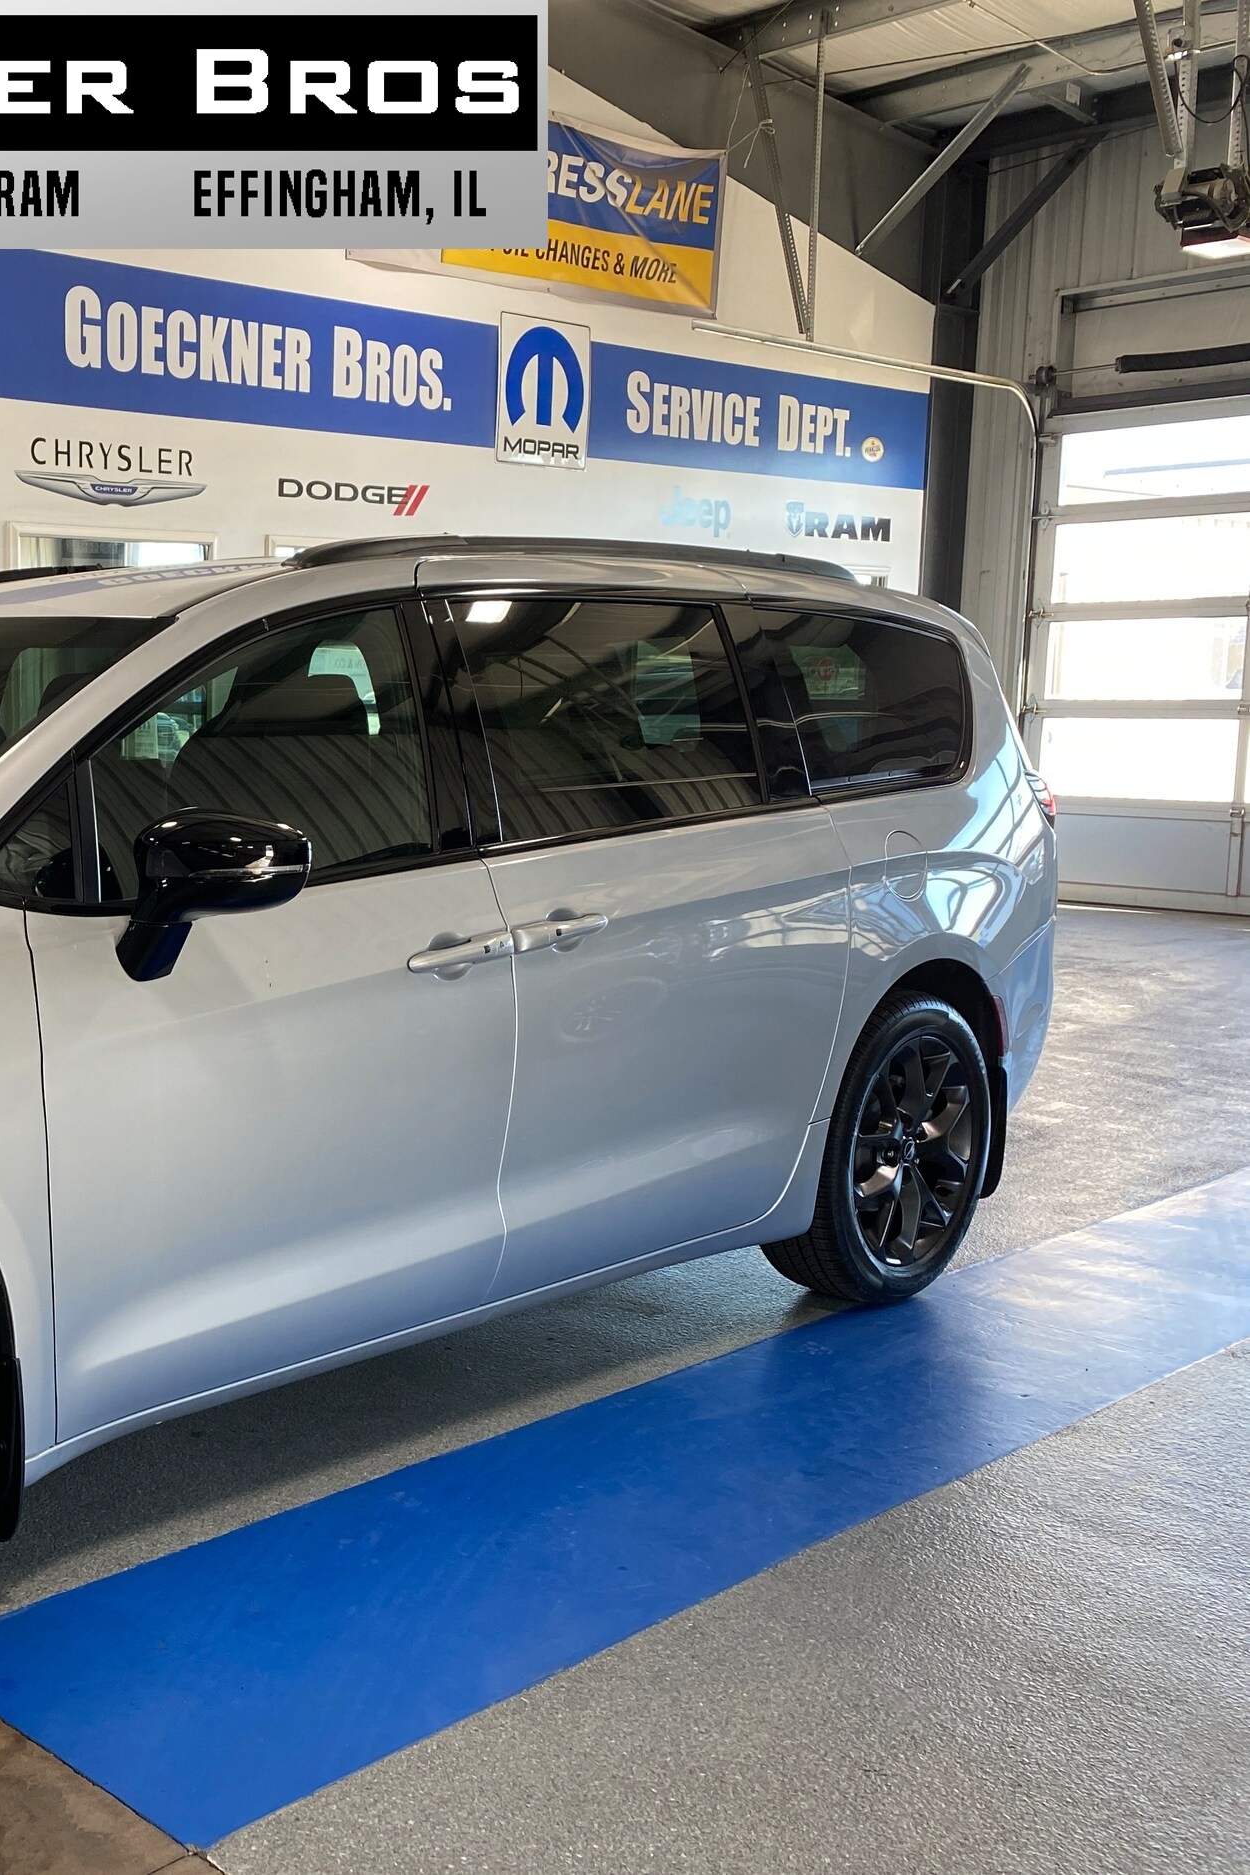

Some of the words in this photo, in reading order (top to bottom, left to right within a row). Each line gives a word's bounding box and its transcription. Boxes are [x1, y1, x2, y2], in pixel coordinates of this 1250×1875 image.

[613, 252, 625, 276] &
[630, 255, 677, 284] MORE
[64, 284, 312, 394] GOECKNER
[332, 325, 453, 412] BROS.
[626, 369, 760, 448] SERVICE
[777, 393, 851, 458] DEPT.
[29, 437, 194, 478] CHRYSLER
[503, 435, 580, 460] MOPAR
[94, 484, 133, 494] CHRYSLER
[278, 477, 409, 505] DODGE
[659, 485, 732, 538] Jeep
[804, 511, 892, 543] RAM
